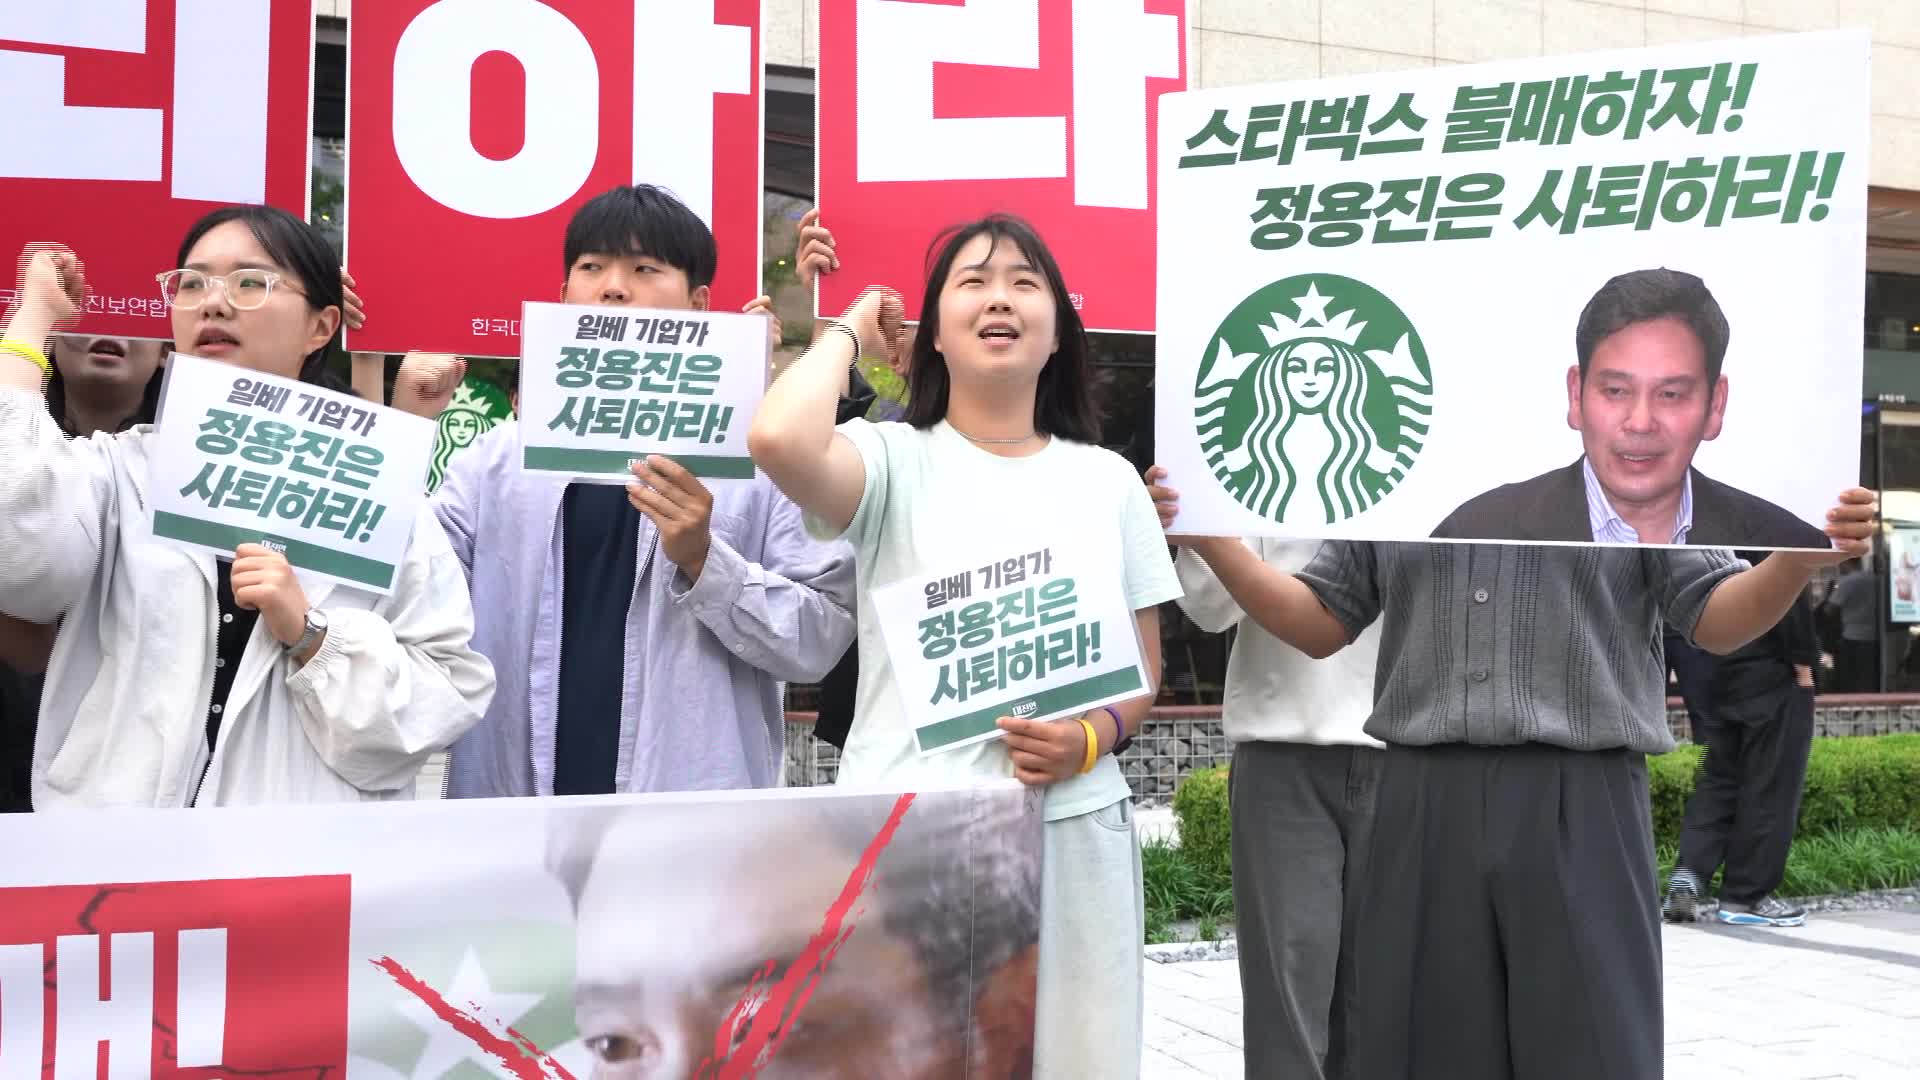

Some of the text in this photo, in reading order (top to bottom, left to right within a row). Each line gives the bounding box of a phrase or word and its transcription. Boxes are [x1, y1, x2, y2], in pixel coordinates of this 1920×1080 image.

[1178, 62, 1759, 169] 스타벅스 불매하자!
[1249, 150, 1846, 252] 정용진은 사퇴하라!
[555, 346, 723, 396] 정용진은
[575, 314, 710, 347] 일베 기업가
[226, 378, 378, 437] 일베 기업가
[547, 396, 735, 444] 사퇴하라!
[195, 408, 385, 490] 정용진은
[179, 462, 387, 543] 사퇴하라!
[918, 577, 1078, 660] 정용진은
[924, 547, 1053, 610] 일베 기업가
[929, 620, 1102, 706] 사퇴하라!
